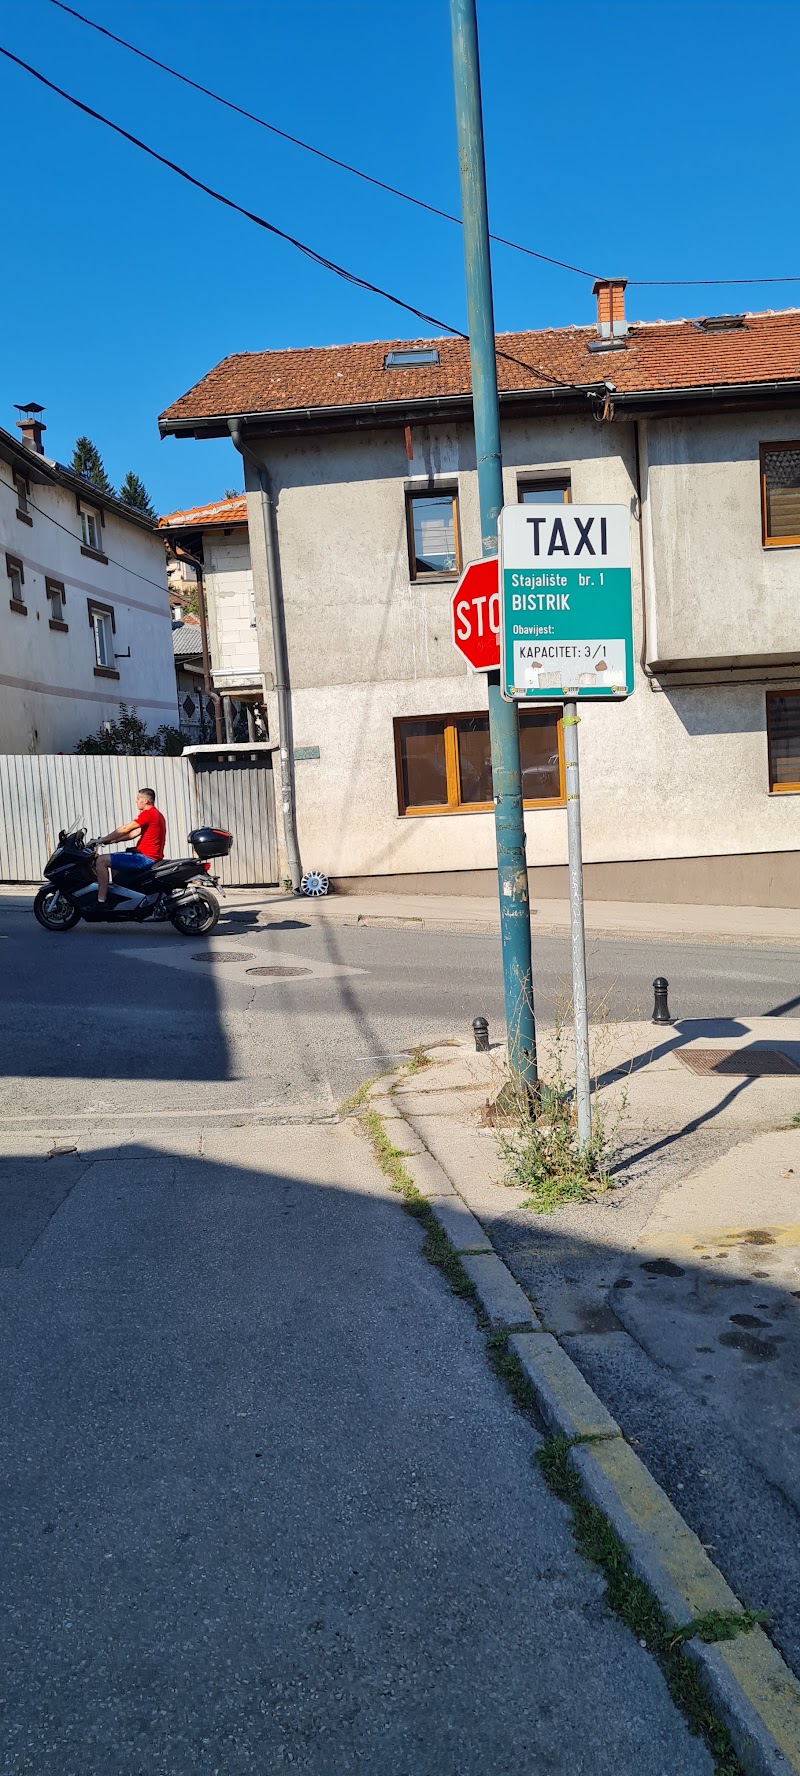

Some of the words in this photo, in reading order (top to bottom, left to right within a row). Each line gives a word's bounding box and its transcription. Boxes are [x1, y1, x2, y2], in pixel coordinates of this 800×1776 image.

[526, 517, 608, 556] TAXI
[511, 573, 568, 590] Stajalište
[578, 572, 595, 586] br.
[599, 572, 605, 586] 1
[511, 593, 571, 611] BISTRIK
[456, 592, 500, 640] STO
[512, 624, 555, 637] Obavijest:
[519, 645, 581, 658] KAPACITET:
[584, 644, 607, 659] 3/1
